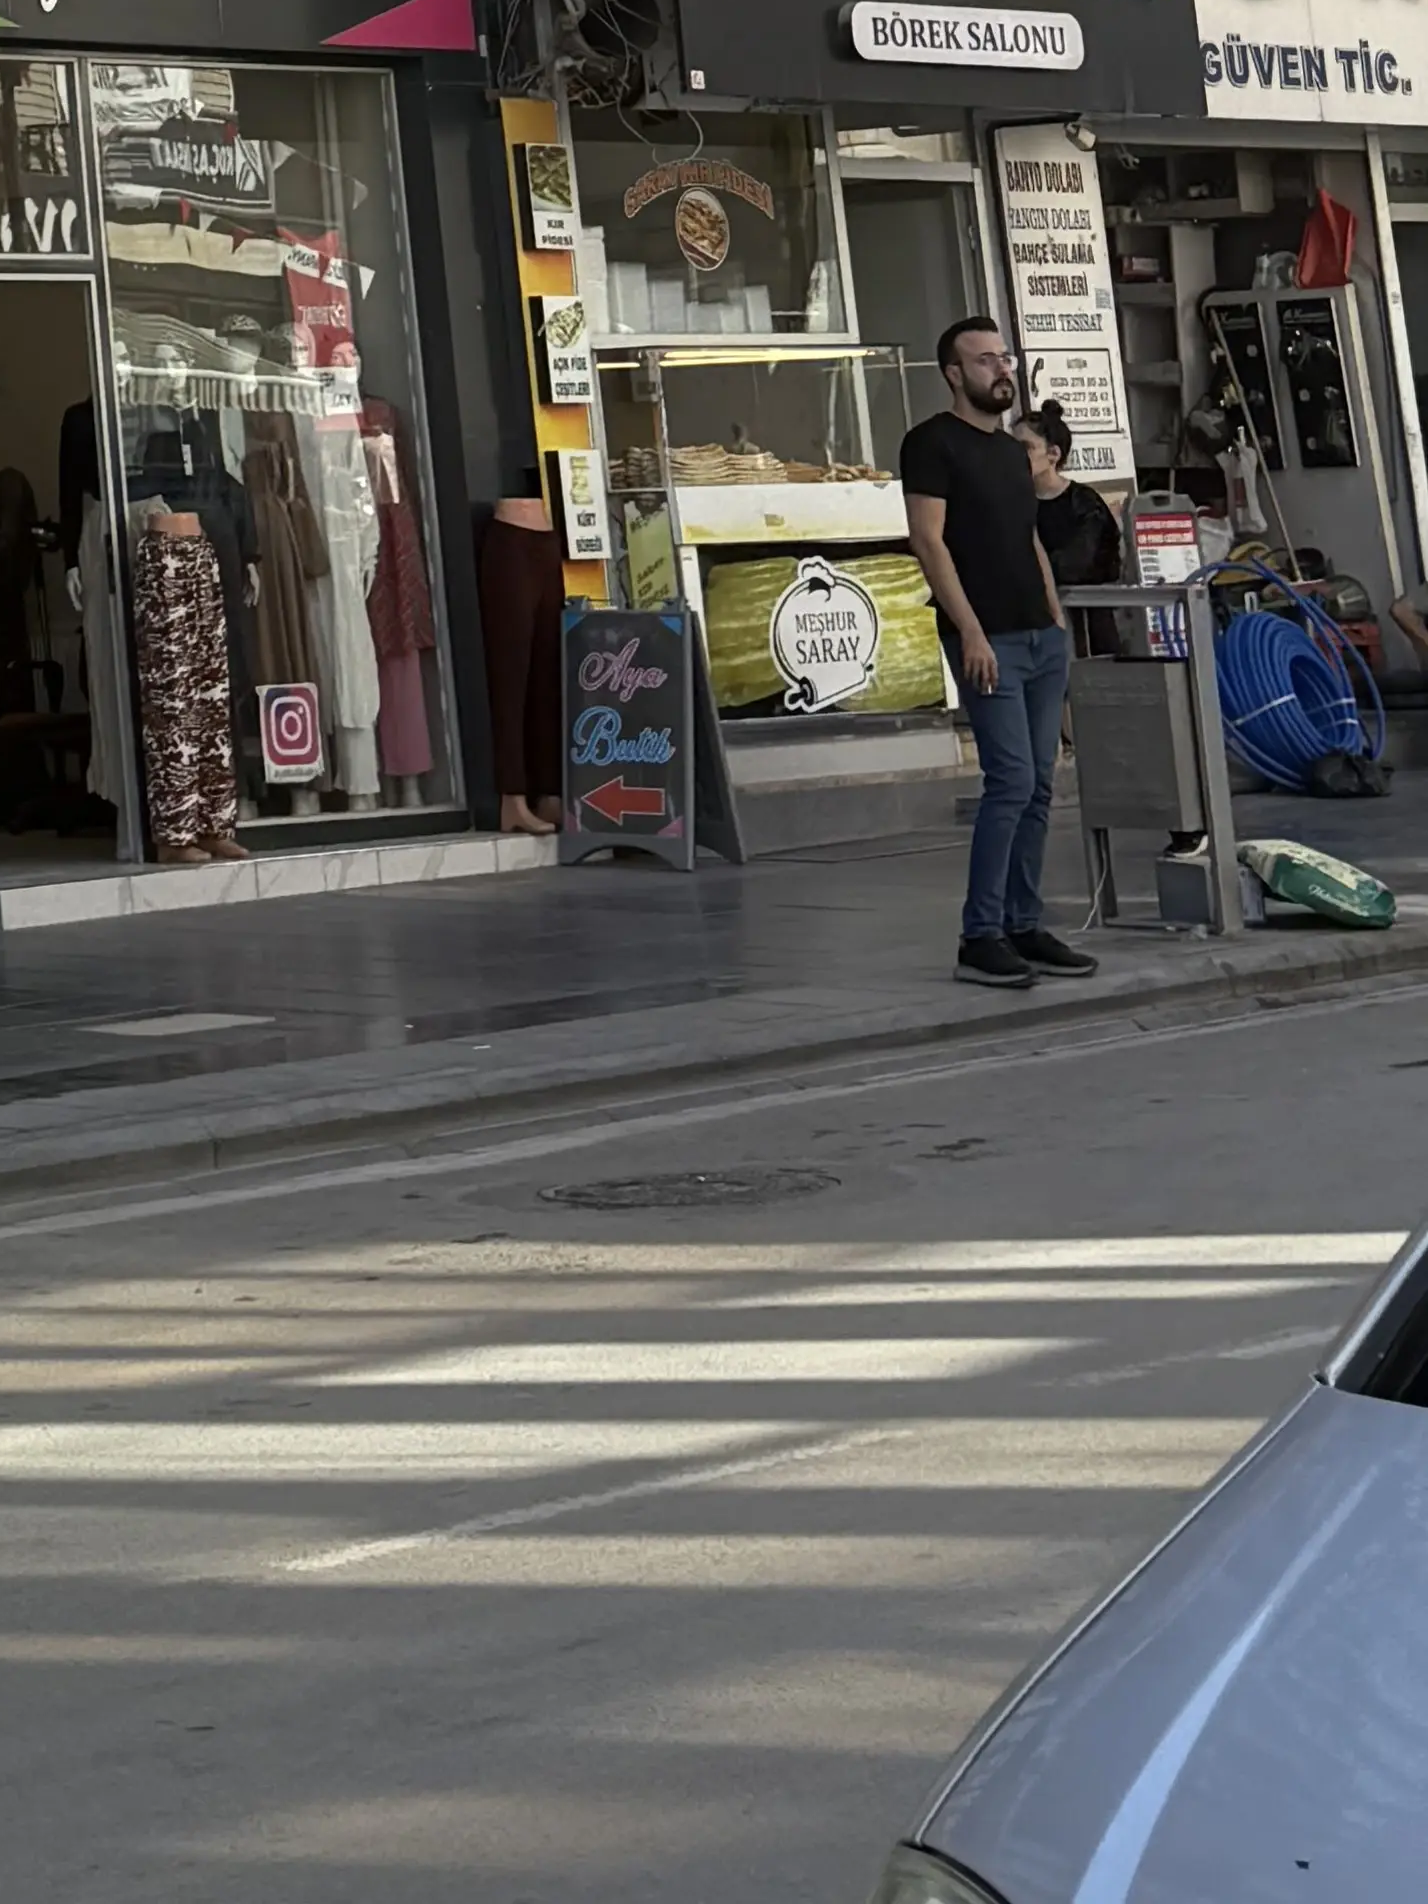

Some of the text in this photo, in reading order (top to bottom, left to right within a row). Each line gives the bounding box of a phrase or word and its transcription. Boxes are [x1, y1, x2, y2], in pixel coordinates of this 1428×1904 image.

[871, 10, 1066, 56] BÖREK SALONU
[1202, 32, 1329, 91] GÜVEN
[1005, 160, 1084, 194] BANYO DOLABI
[1008, 207, 1092, 230] YANGIN DOLABI
[1013, 242, 1095, 266] BAHÇE SULAMA
[1028, 270, 1089, 297] SİSTEMLERİ
[795, 611, 858, 635] MEŞHUR
[796, 636, 861, 664] SARAY
[578, 638, 668, 703] Aya
[570, 706, 676, 766] Butik
